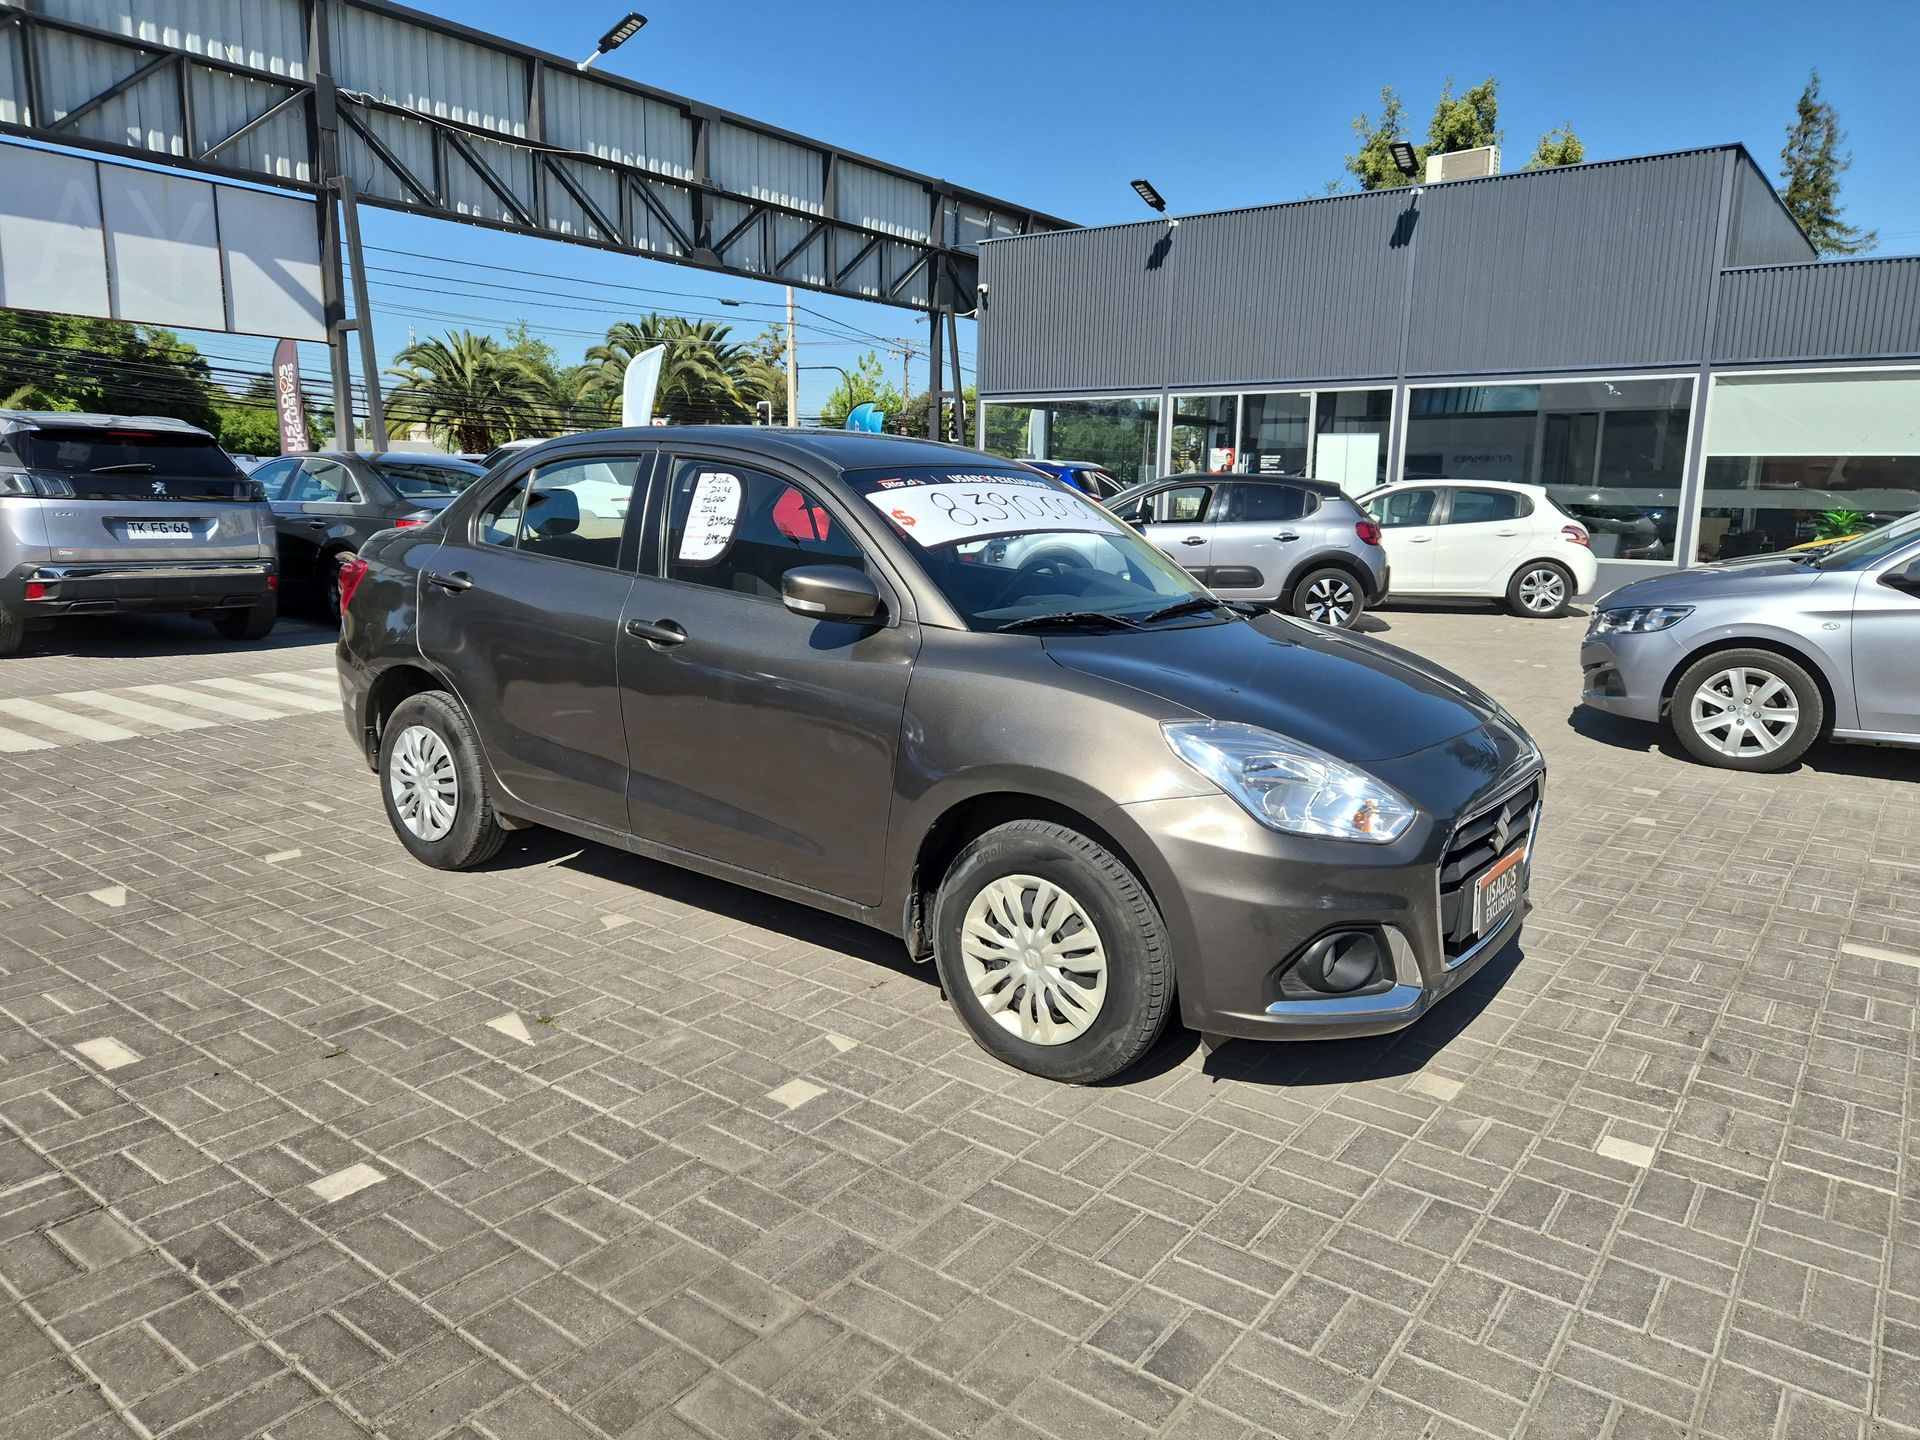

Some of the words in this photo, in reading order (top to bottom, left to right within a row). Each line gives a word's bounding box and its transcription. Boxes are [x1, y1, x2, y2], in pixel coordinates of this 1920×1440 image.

[279, 364, 297, 452] USADOS
[946, 474, 992, 483] USADOS
[892, 508, 916, 527] $
[1486, 864, 1517, 906] USADOS
[1486, 885, 1517, 923] EXCLUSIVOS
